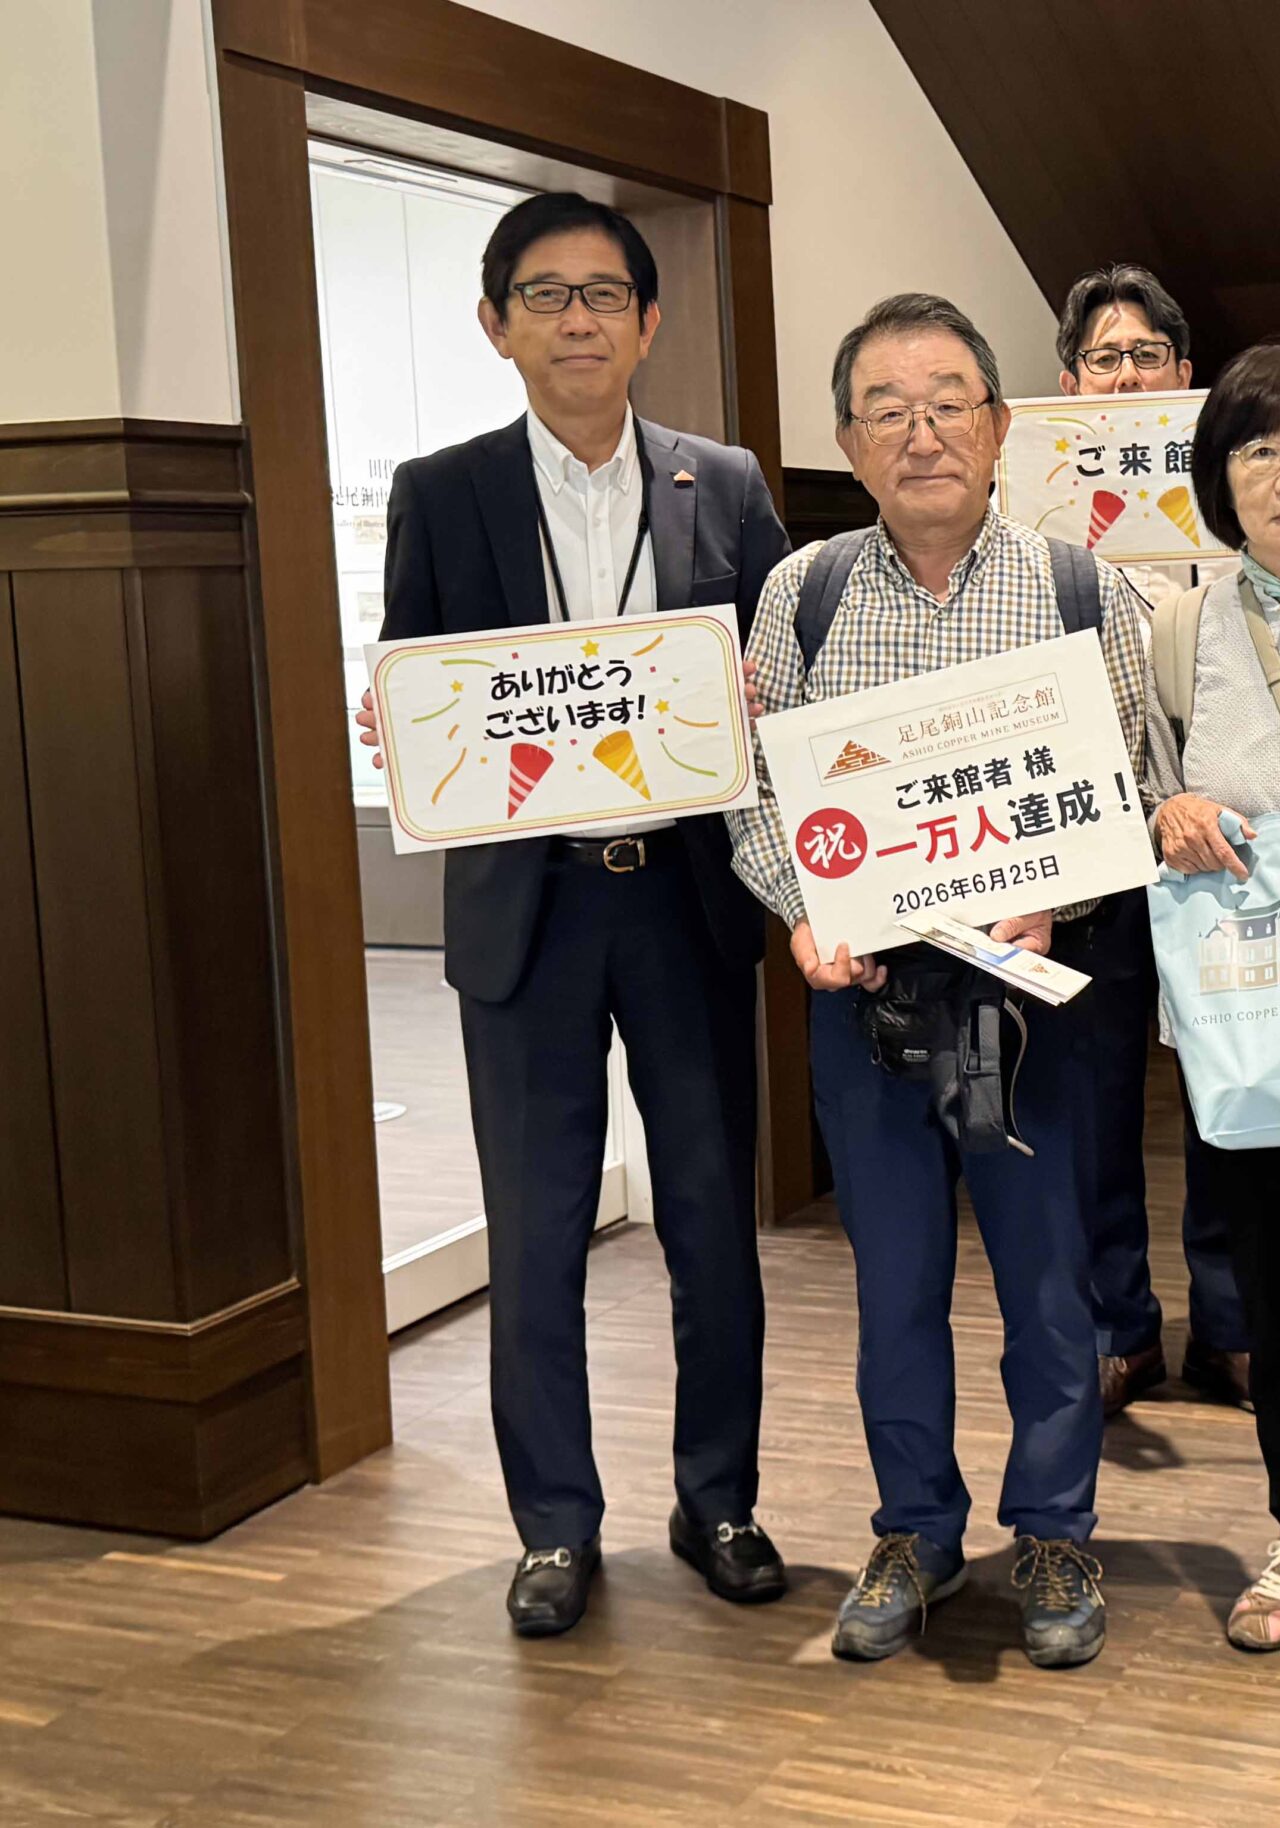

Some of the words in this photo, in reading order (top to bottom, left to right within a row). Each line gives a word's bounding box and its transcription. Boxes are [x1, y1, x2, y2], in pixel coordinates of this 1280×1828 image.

[490, 658, 633, 701] ありがとう
[484, 694, 647, 740] ございます!
[898, 686, 1056, 745] 足尾銅山記念館
[901, 744, 935, 760] ASHIO
[936, 733, 978, 751] COPPER
[980, 724, 1011, 740] MINE
[1013, 711, 1061, 731] MUSEUM
[895, 757, 1013, 810] ご来館者
[1023, 745, 1057, 781] 様
[803, 822, 863, 870] 祝
[875, 770, 1132, 865] 一万人達成！
[892, 854, 1061, 915] 2026年6月25日
[1191, 1012, 1232, 1027] ASHIO
